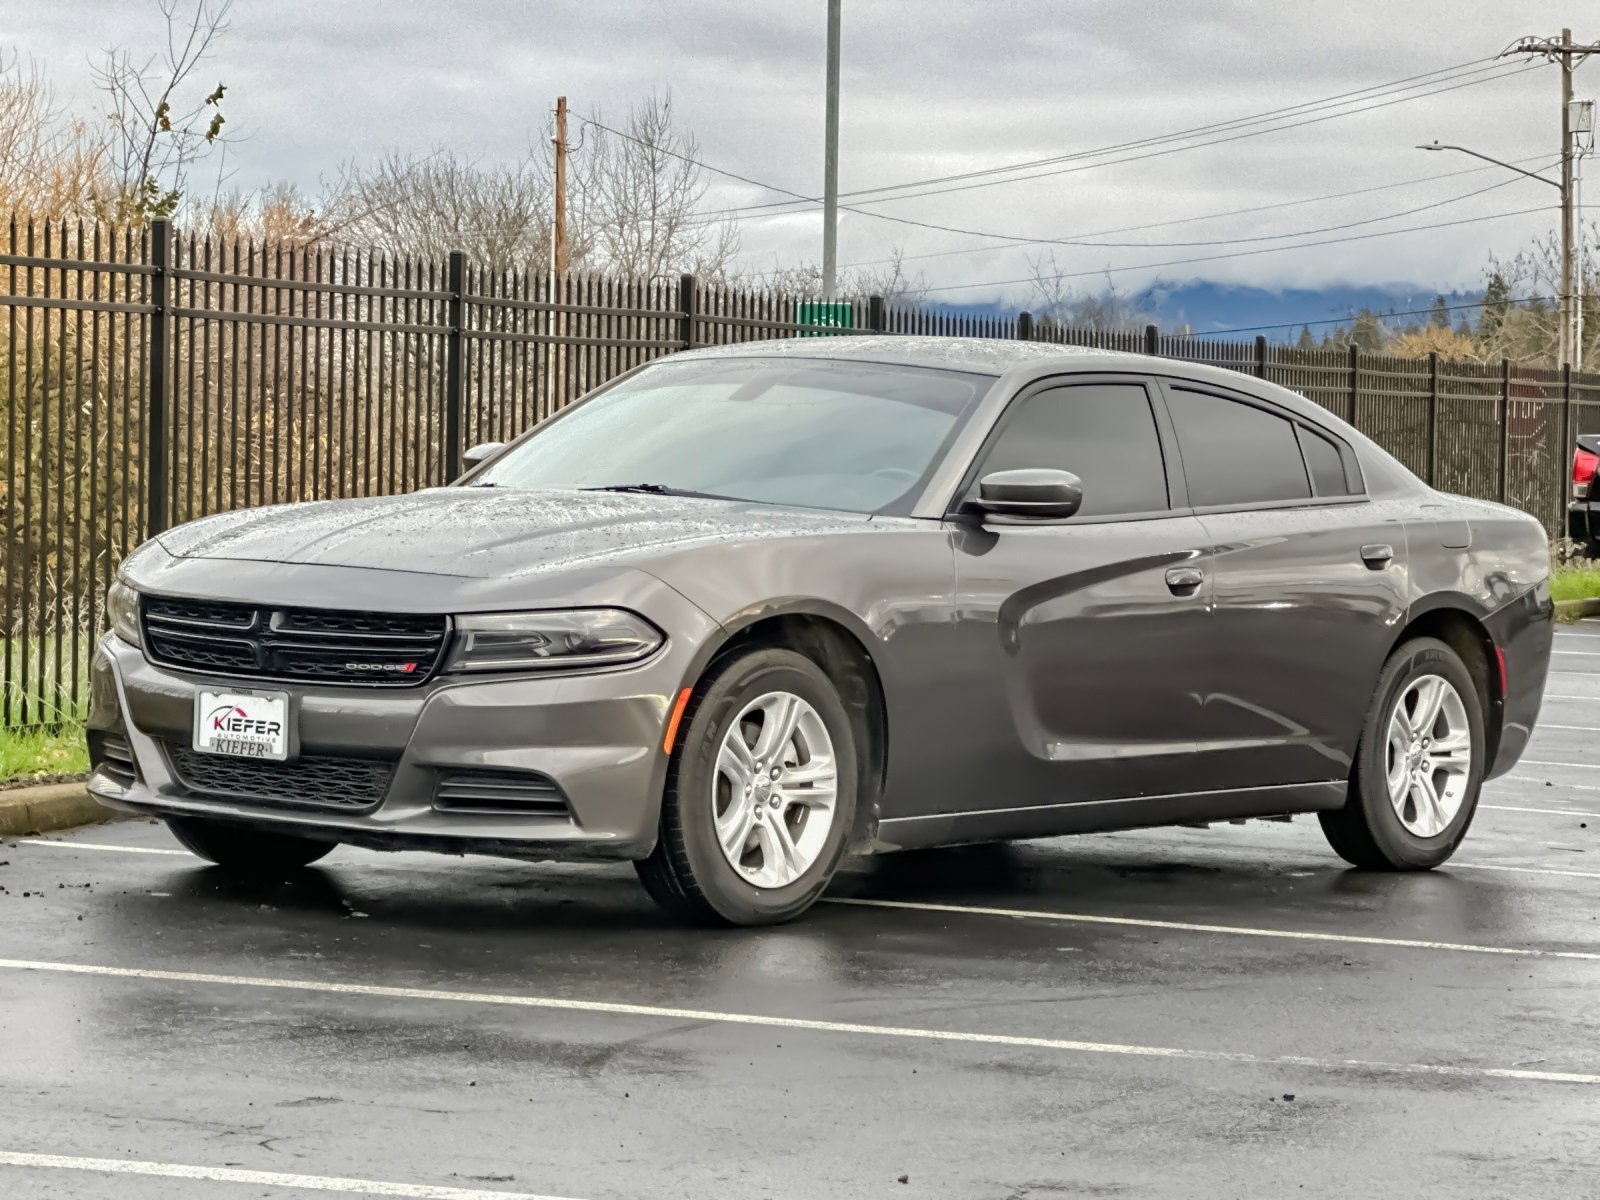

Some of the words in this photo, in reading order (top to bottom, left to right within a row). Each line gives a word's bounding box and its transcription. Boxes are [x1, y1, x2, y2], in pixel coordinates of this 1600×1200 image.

[345, 663, 408, 671] DODGE
[213, 715, 281, 736] KIEFER
[216, 732, 277, 743] AUTOMOTIVE
[215, 739, 266, 757] KIEFER
